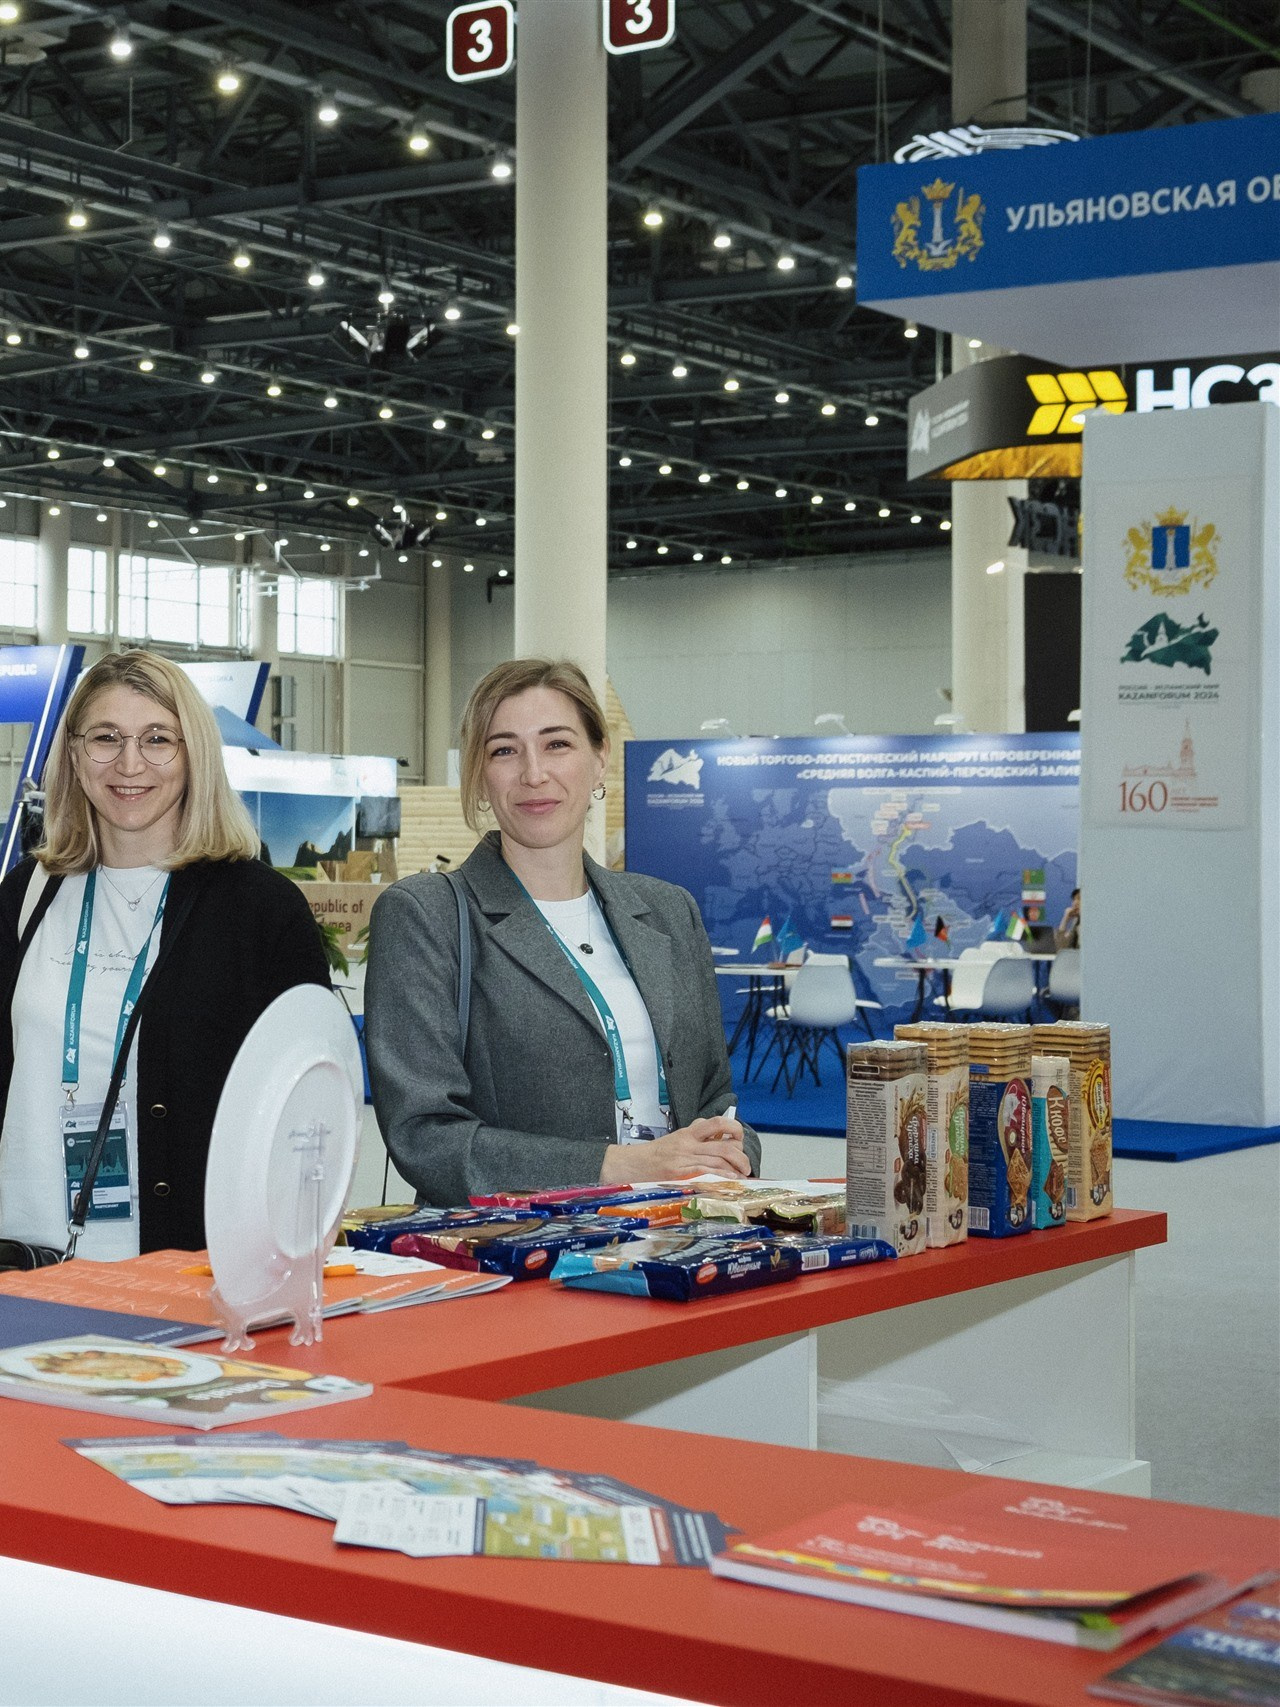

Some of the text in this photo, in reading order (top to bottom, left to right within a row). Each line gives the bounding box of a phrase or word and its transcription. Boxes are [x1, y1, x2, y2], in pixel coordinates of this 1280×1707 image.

[624, 0, 654, 35] 3
[466, 18, 494, 63] 3
[1004, 179, 1237, 233] УЛЬЯНОВСКАЯ
[1118, 691, 1191, 700] KAZANFORUM
[1118, 780, 1169, 813] 160
[352, 900, 363, 913] of
[69, 1003, 77, 1045] KAZANFORUM
[611, 1033, 624, 1079] KAZANFORUM
[912, 1115, 920, 1165] Формула
